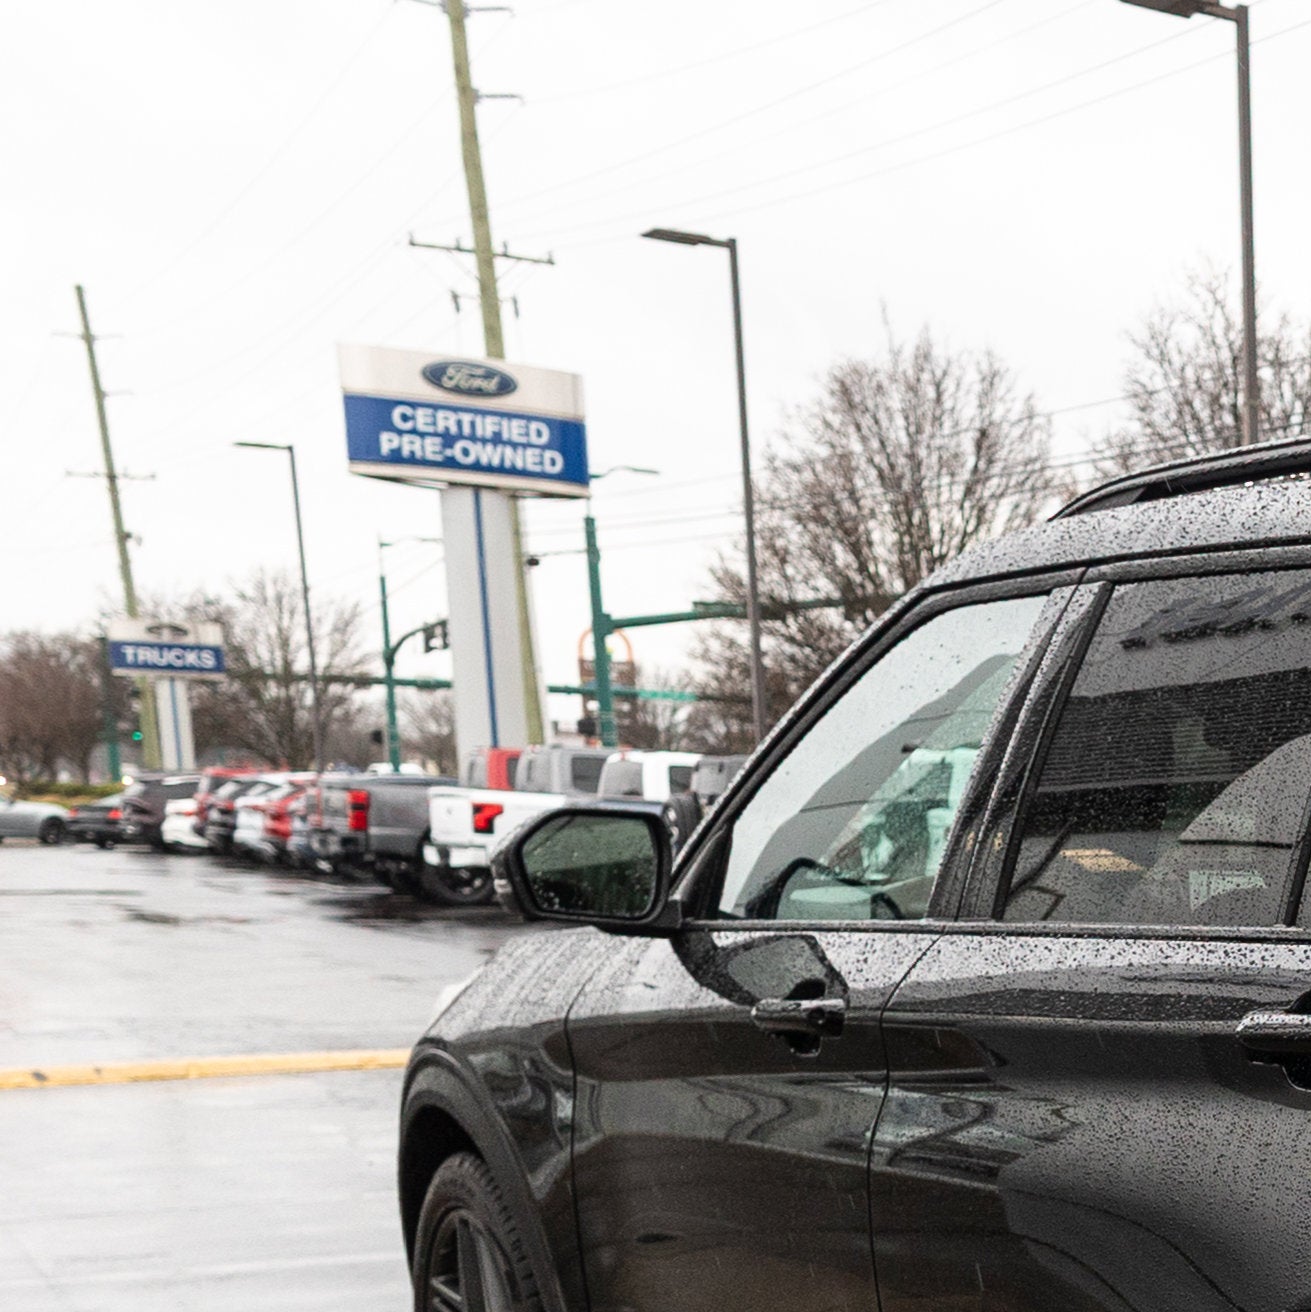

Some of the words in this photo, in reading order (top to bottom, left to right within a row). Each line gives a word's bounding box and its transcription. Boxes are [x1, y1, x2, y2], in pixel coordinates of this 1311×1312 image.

[391, 404, 550, 446] CERTIFIED
[379, 432, 564, 475] PRE-OWNED
[121, 645, 217, 669] TRUCKS
